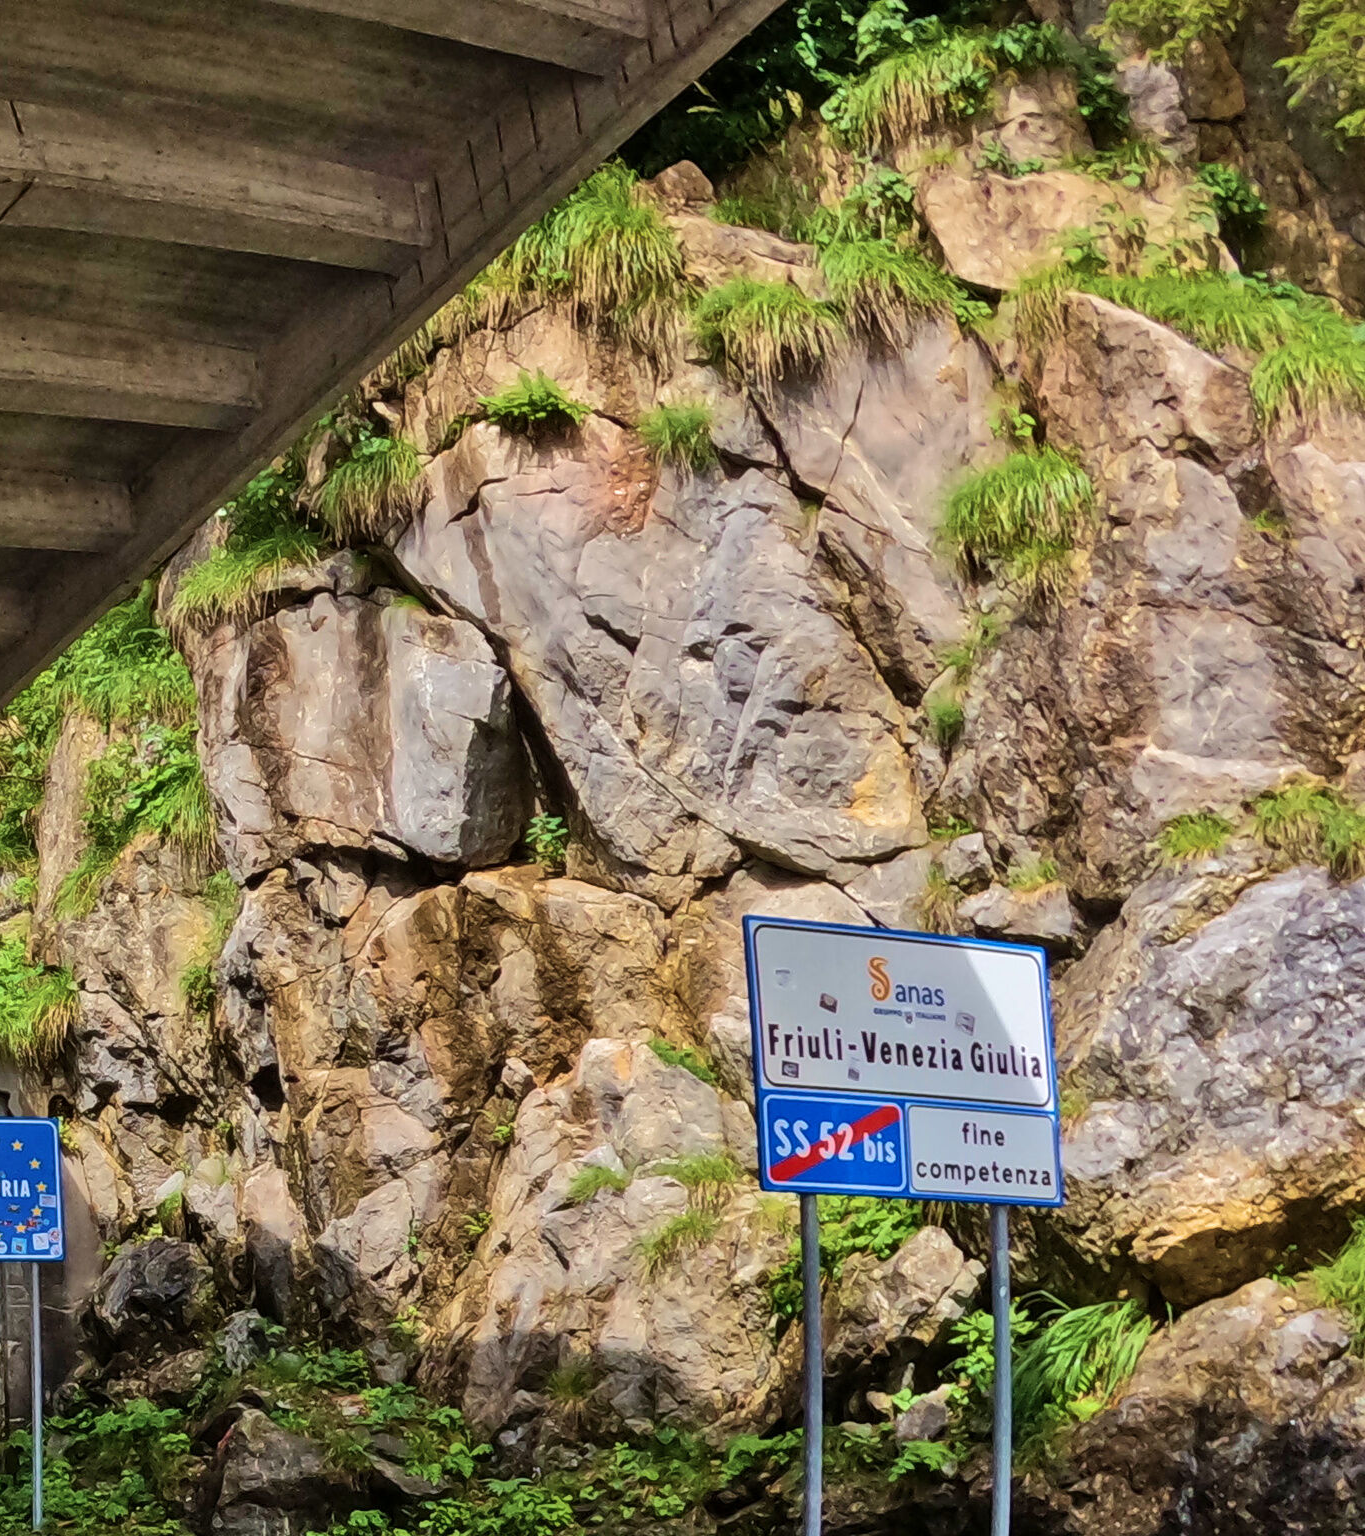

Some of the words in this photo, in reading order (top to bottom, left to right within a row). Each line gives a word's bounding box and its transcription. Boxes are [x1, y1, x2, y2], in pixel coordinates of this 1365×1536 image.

[895, 984, 945, 1007] anas
[768, 1023, 963, 1071] Friuli-Venezia
[970, 1041, 1043, 1078] Giulia
[773, 1118, 812, 1158] SS
[818, 1121, 855, 1160] 52
[863, 1132, 896, 1163] bis
[962, 1121, 1005, 1147] fine
[916, 1161, 1052, 1186] competenza
